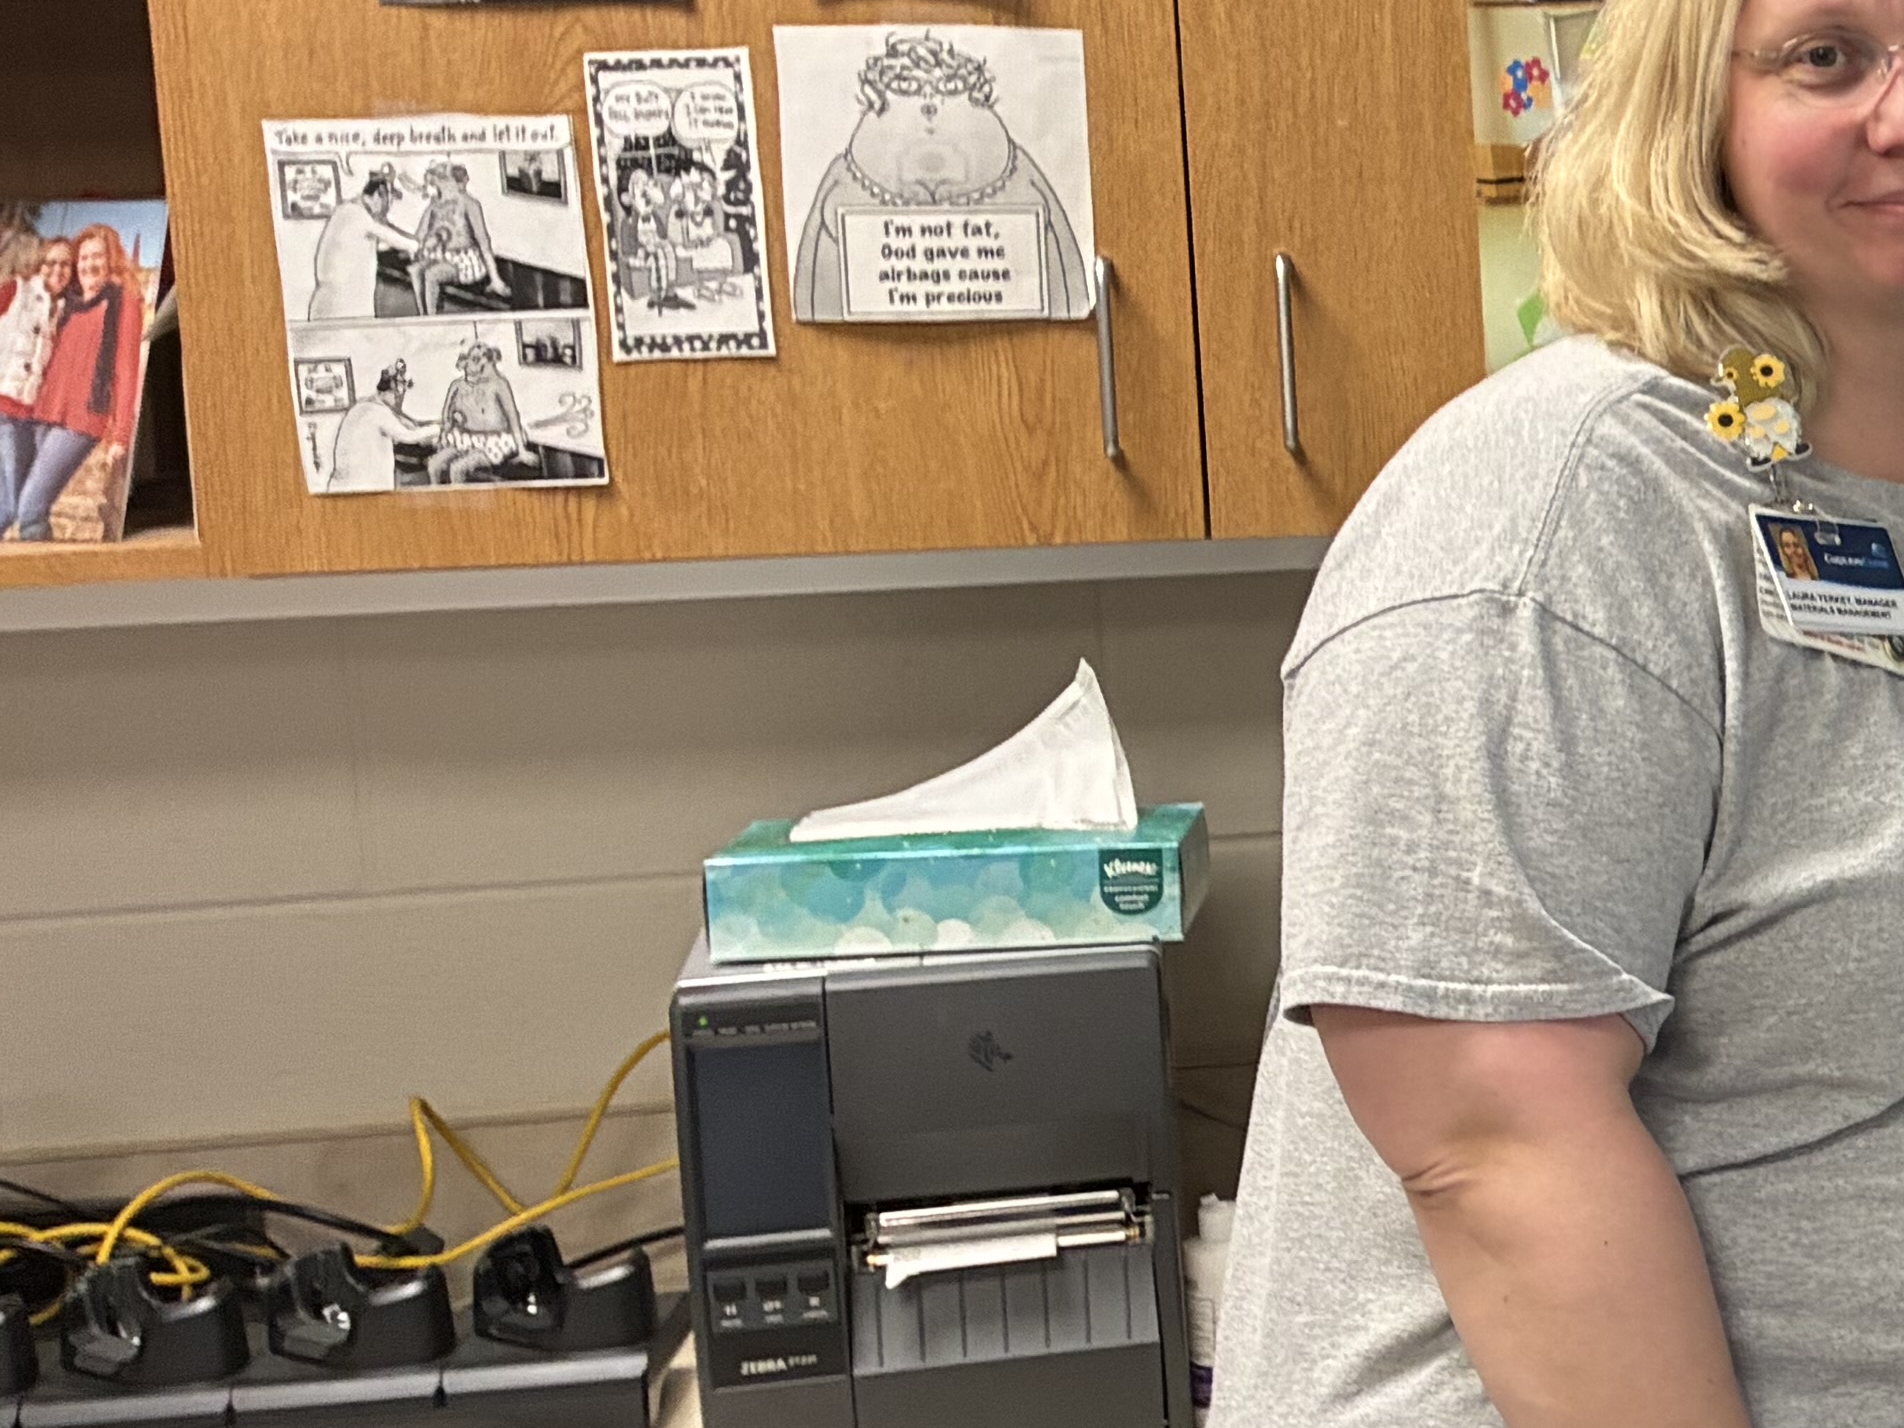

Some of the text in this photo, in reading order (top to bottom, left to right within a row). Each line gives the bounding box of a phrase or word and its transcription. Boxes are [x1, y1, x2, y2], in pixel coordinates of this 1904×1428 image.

[275, 127, 308, 146] Take
[314, 132, 323, 145] a
[373, 127, 405, 153] deep
[409, 124, 456, 145] breath
[461, 126, 487, 143] and
[493, 123, 511, 143] let
[516, 123, 527, 142] it
[883, 219, 1001, 240] I'm not fat,
[923, 245, 970, 264] gave
[977, 245, 1006, 260] me
[878, 265, 1011, 285] airbags cause
[888, 286, 1003, 309] I'm precious
[741, 1357, 787, 1375] ZEBRA
